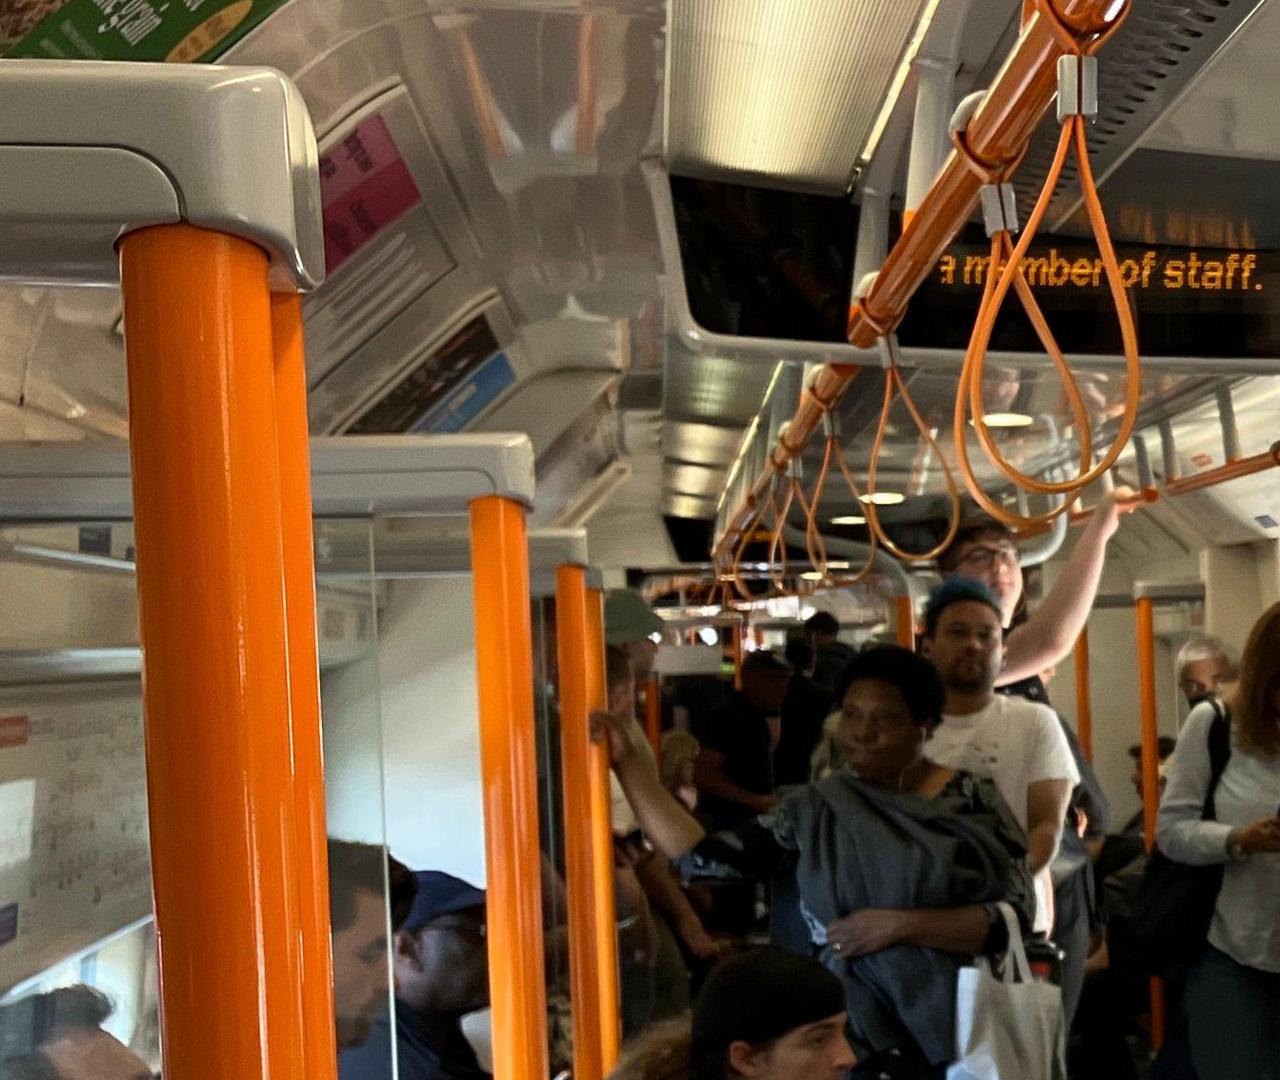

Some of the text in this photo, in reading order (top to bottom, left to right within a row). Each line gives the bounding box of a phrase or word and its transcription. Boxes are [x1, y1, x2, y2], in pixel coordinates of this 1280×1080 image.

[938, 248, 1263, 291] a mmber of staff.
